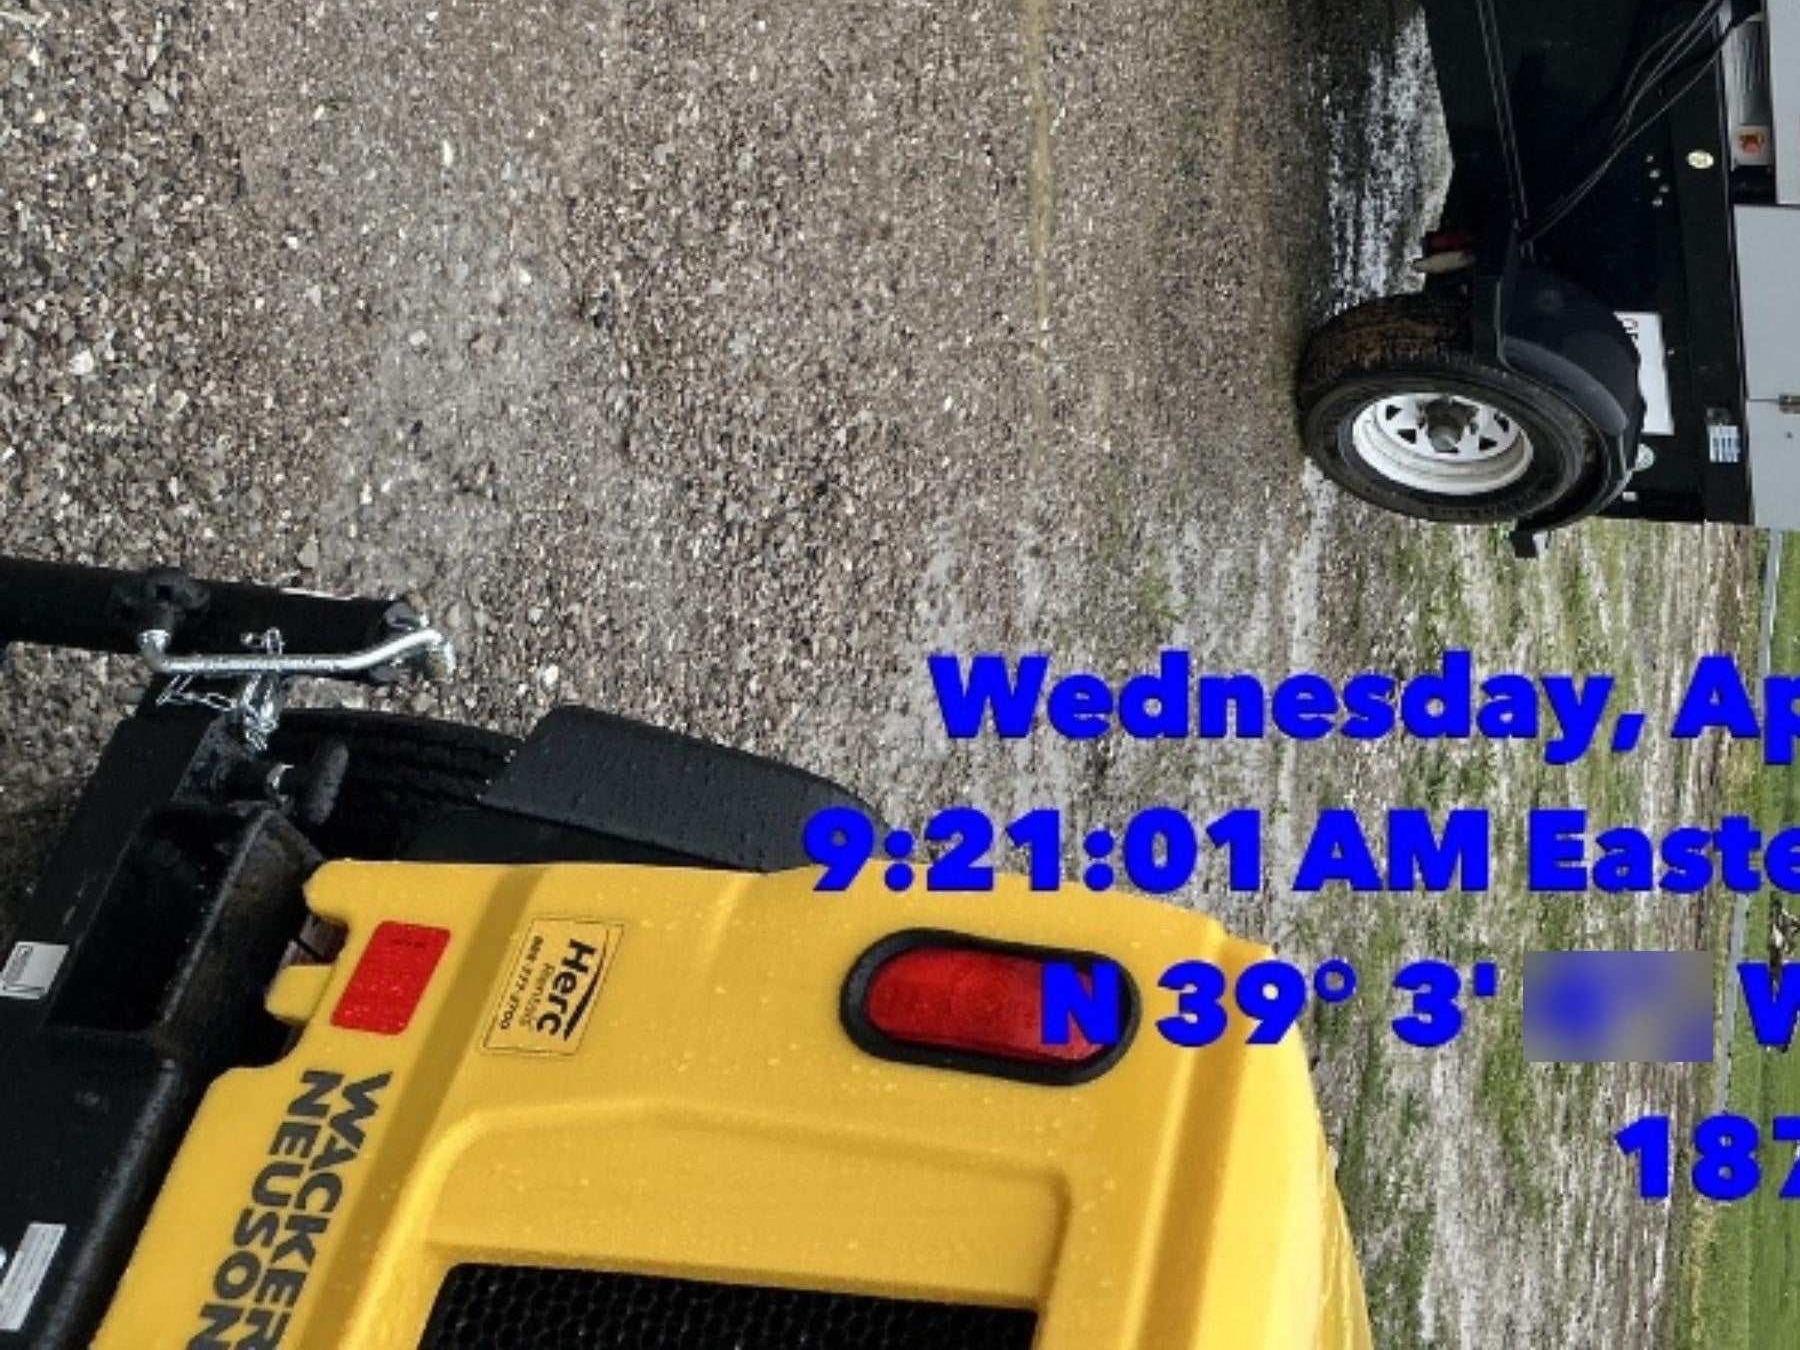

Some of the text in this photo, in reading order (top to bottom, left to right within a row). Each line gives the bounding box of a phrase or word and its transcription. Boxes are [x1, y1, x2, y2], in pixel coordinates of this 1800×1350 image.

[535, 938, 599, 1036] Herc
[186, 1069, 346, 1350] NEUSON
[236, 1070, 394, 1350] WACKER
